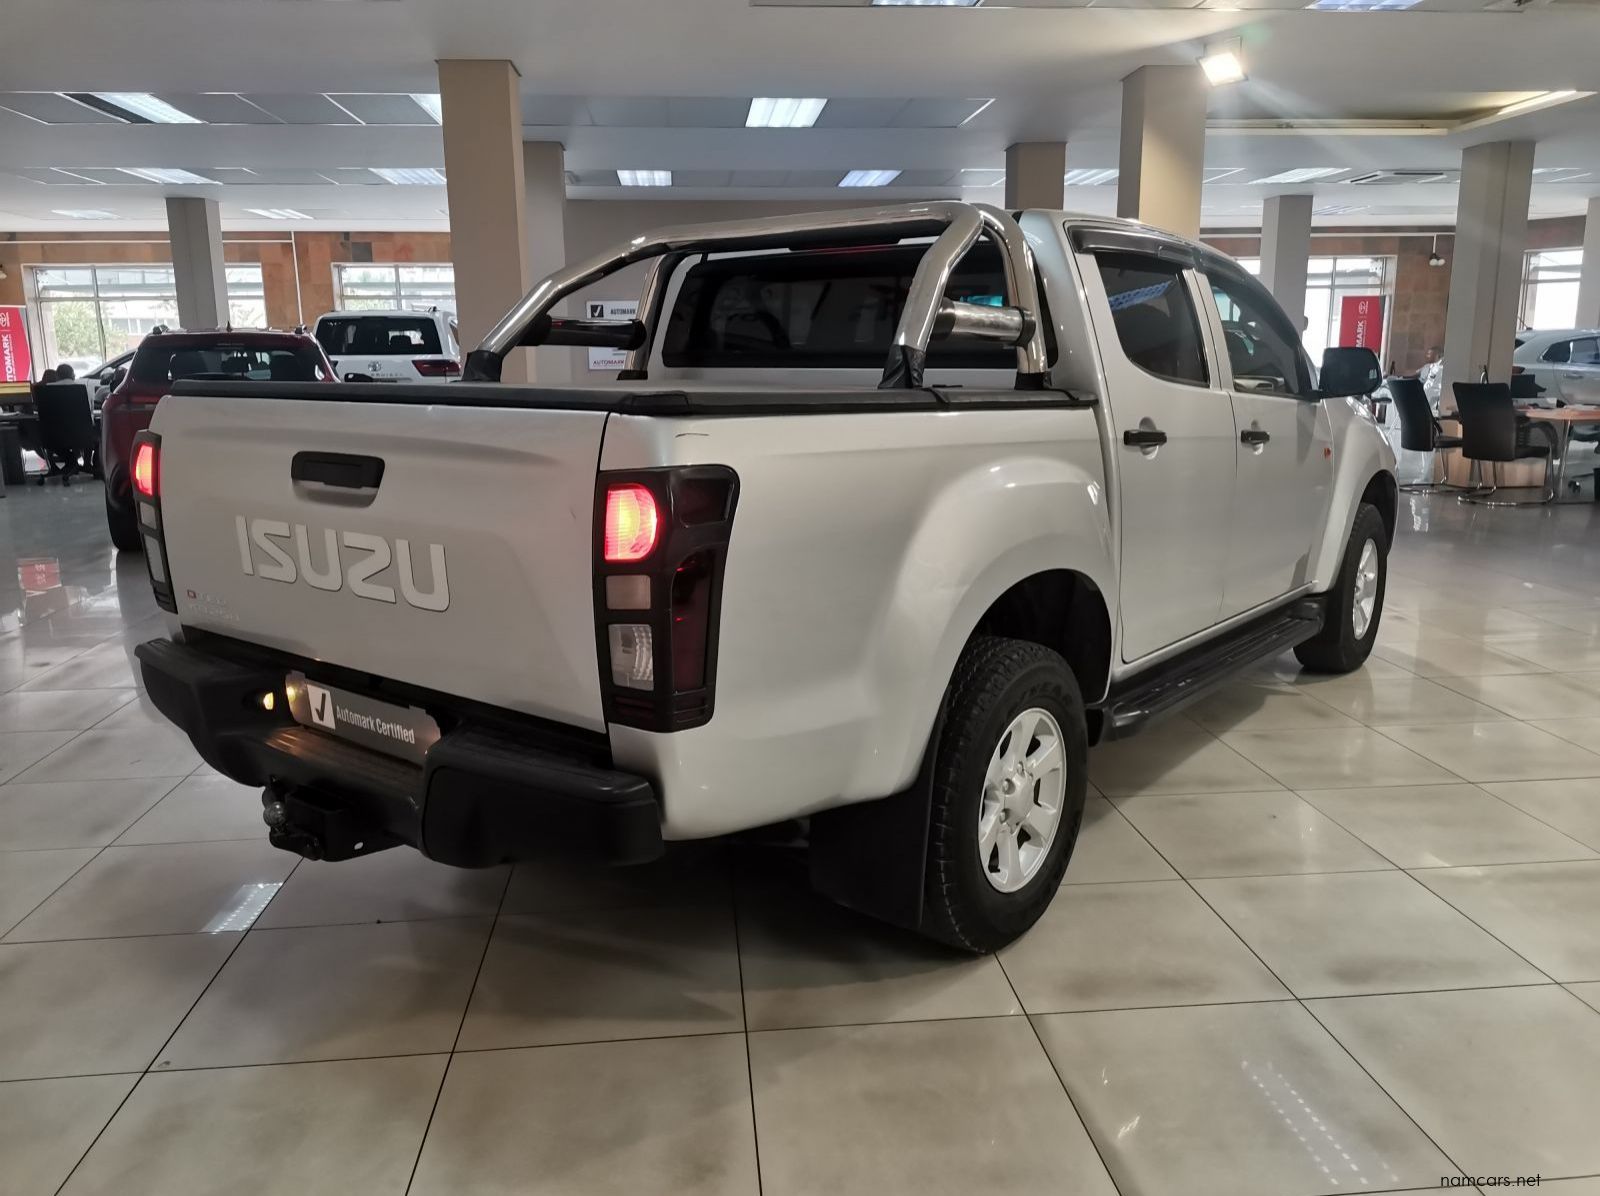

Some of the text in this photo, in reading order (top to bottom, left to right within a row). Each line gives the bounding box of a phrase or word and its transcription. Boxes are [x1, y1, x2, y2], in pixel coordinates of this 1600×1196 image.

[235, 515, 450, 613] ISUZU
[336, 705, 416, 744] Automark Certified
